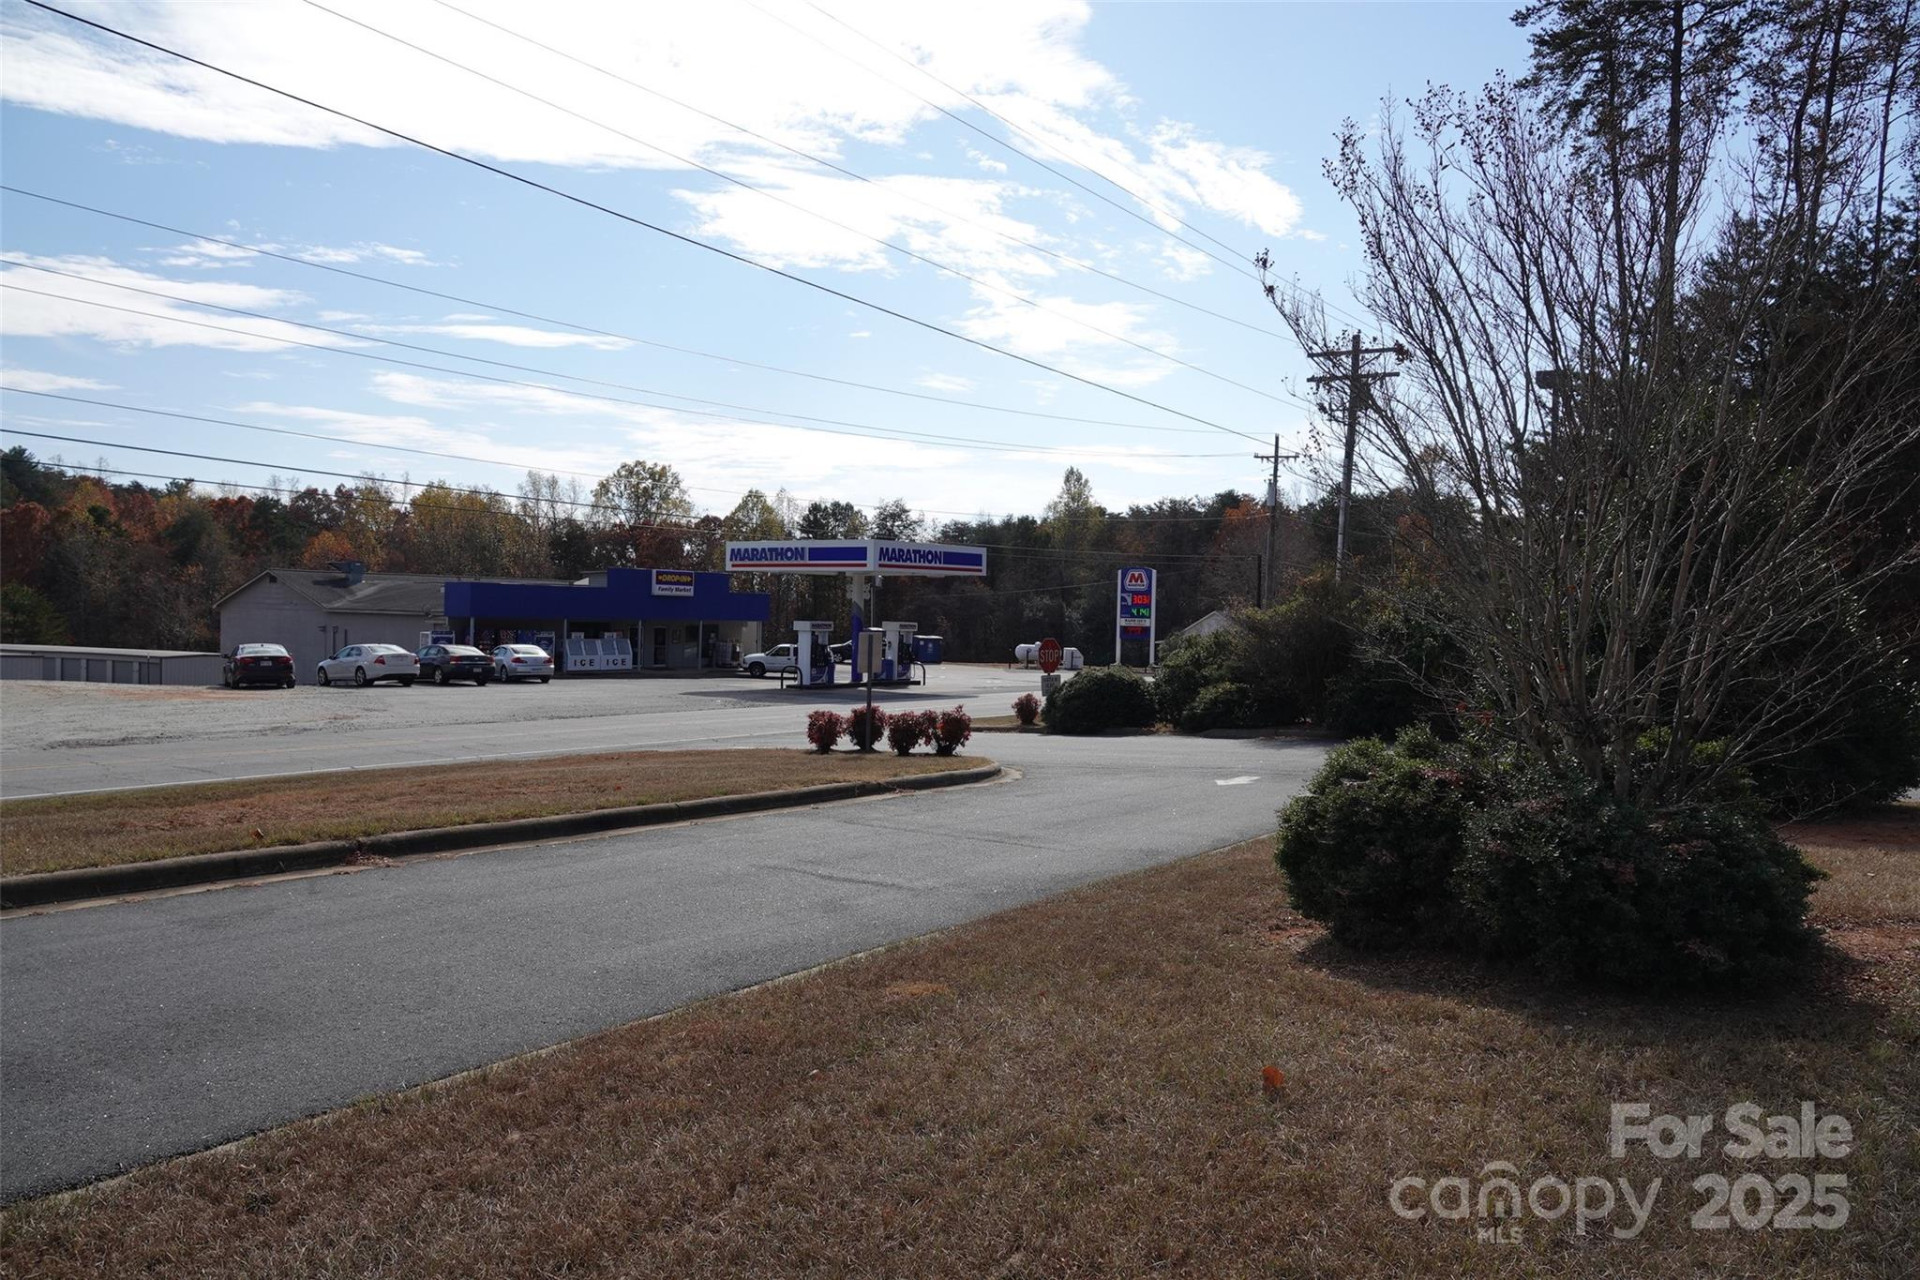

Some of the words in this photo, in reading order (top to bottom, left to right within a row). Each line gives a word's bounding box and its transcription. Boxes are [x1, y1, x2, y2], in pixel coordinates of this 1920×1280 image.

[730, 547, 805, 562] MARATHON
[879, 547, 942, 565] MARATHON
[606, 658, 627, 666] ICE
[1041, 649, 1059, 662] STOP
[573, 659, 595, 667] ICE
